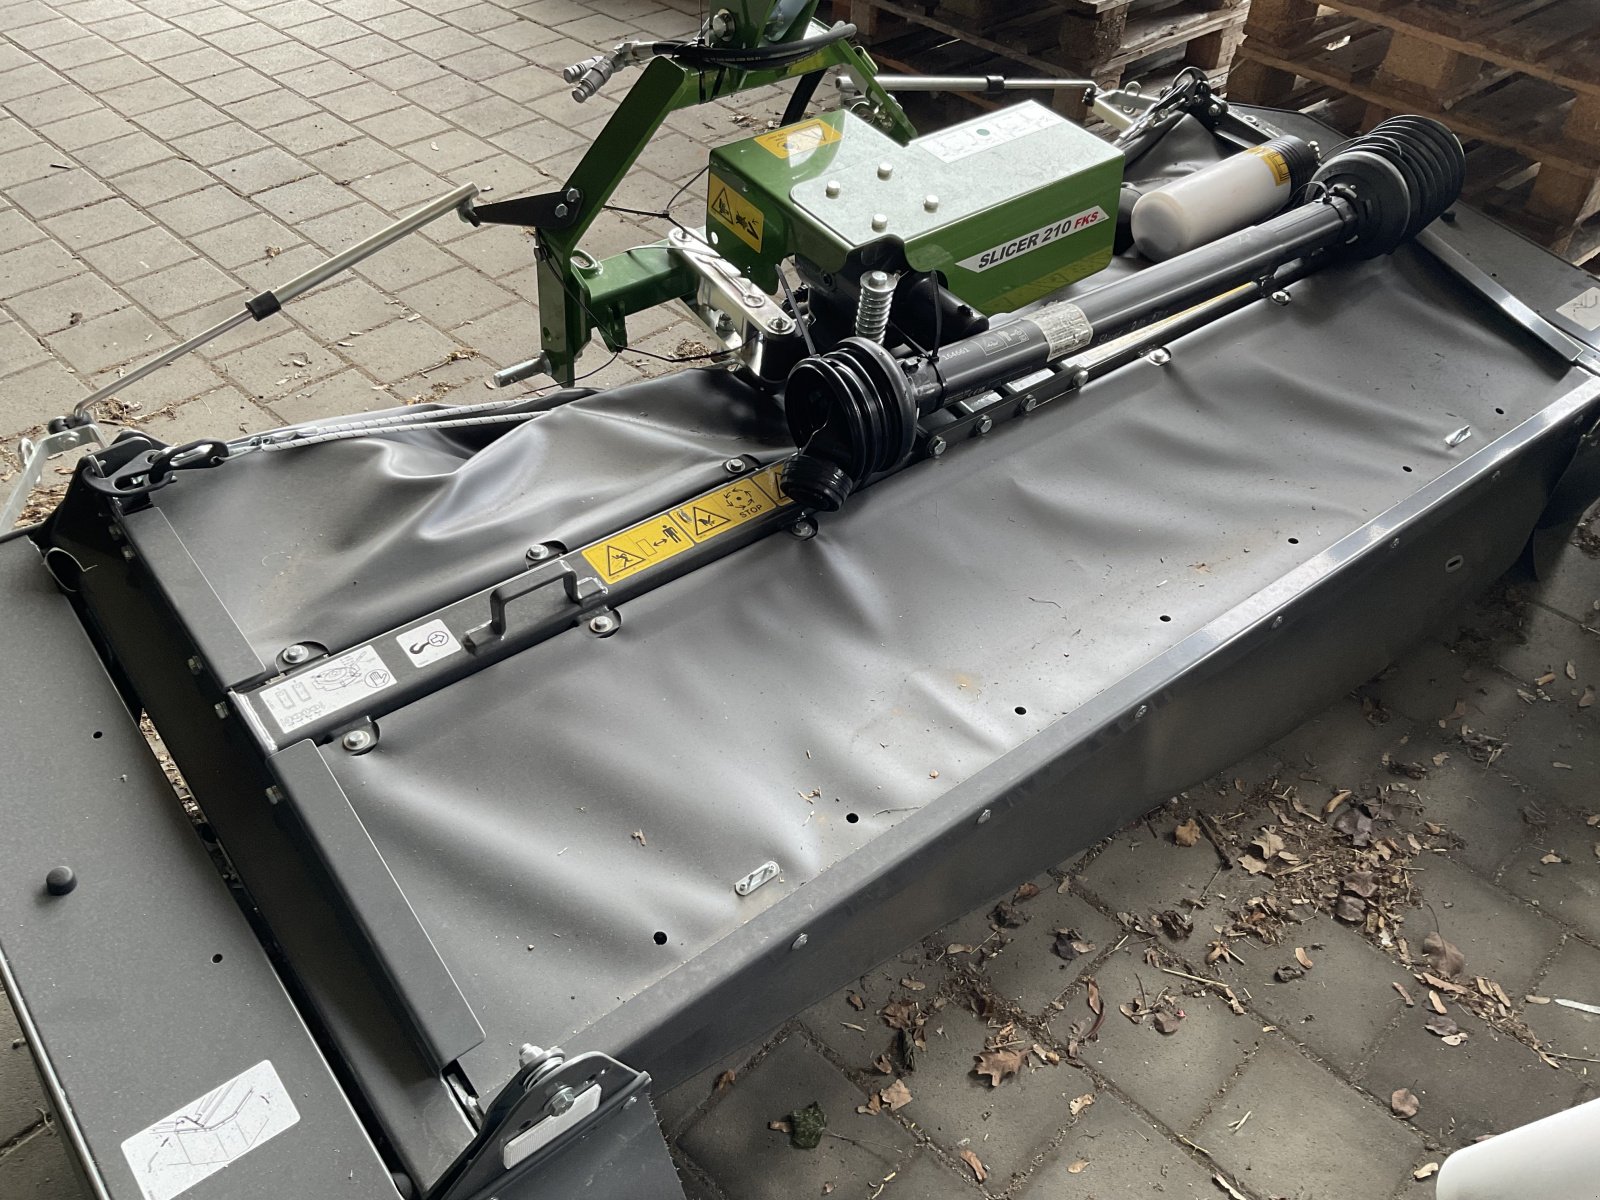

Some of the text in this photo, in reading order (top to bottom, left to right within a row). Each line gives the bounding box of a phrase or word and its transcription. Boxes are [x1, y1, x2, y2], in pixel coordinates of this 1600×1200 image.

[978, 211, 1099, 269] SLICER 210 FKS
[739, 504, 762, 518] STOP
